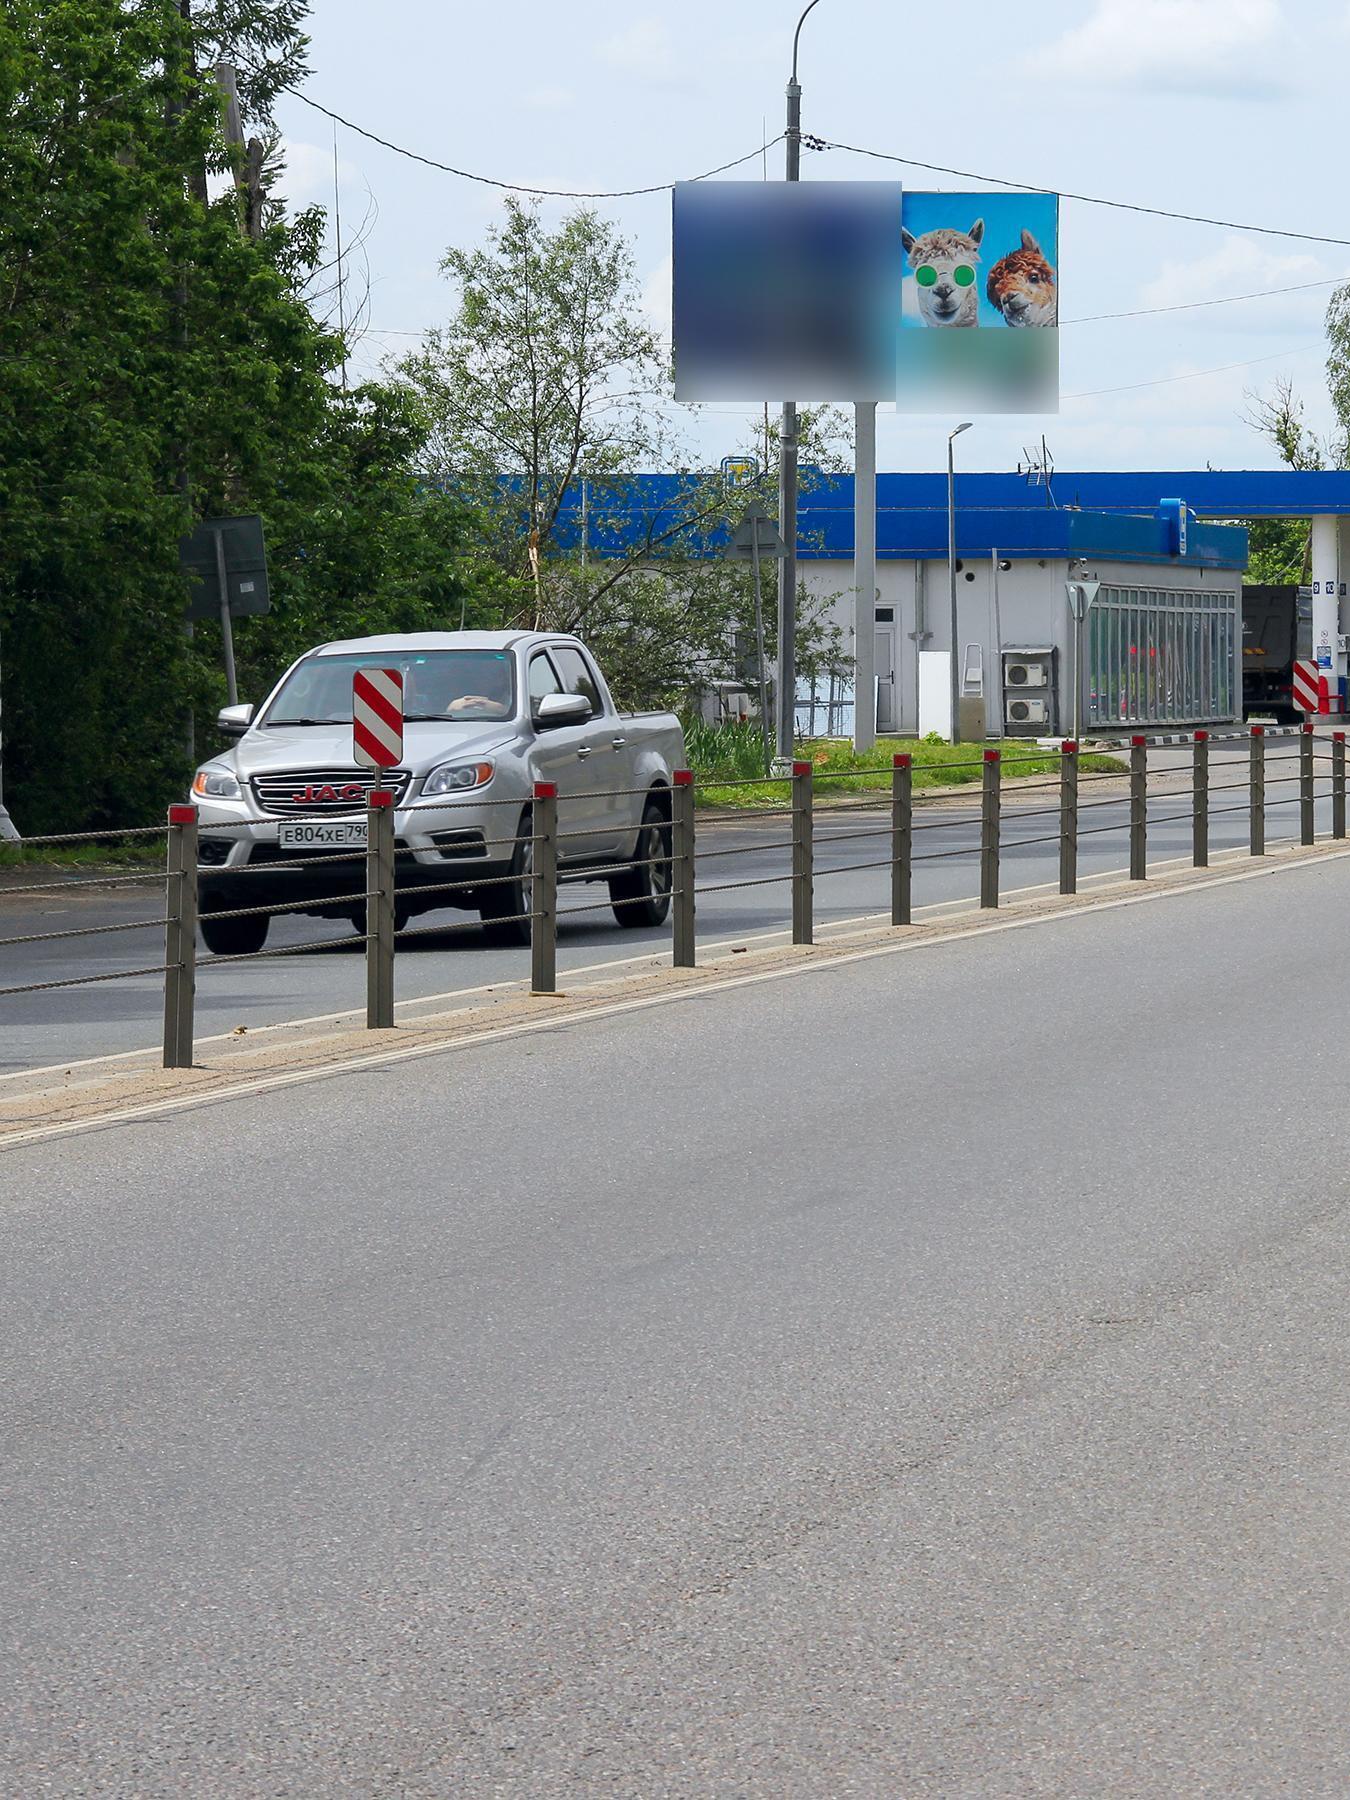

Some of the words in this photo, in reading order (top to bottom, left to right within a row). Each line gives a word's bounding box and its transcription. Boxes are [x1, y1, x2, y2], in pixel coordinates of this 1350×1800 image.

[1326, 584, 1334, 592] 10
[292, 784, 365, 804] JAC
[284, 827, 344, 842] Е804ХЕ
